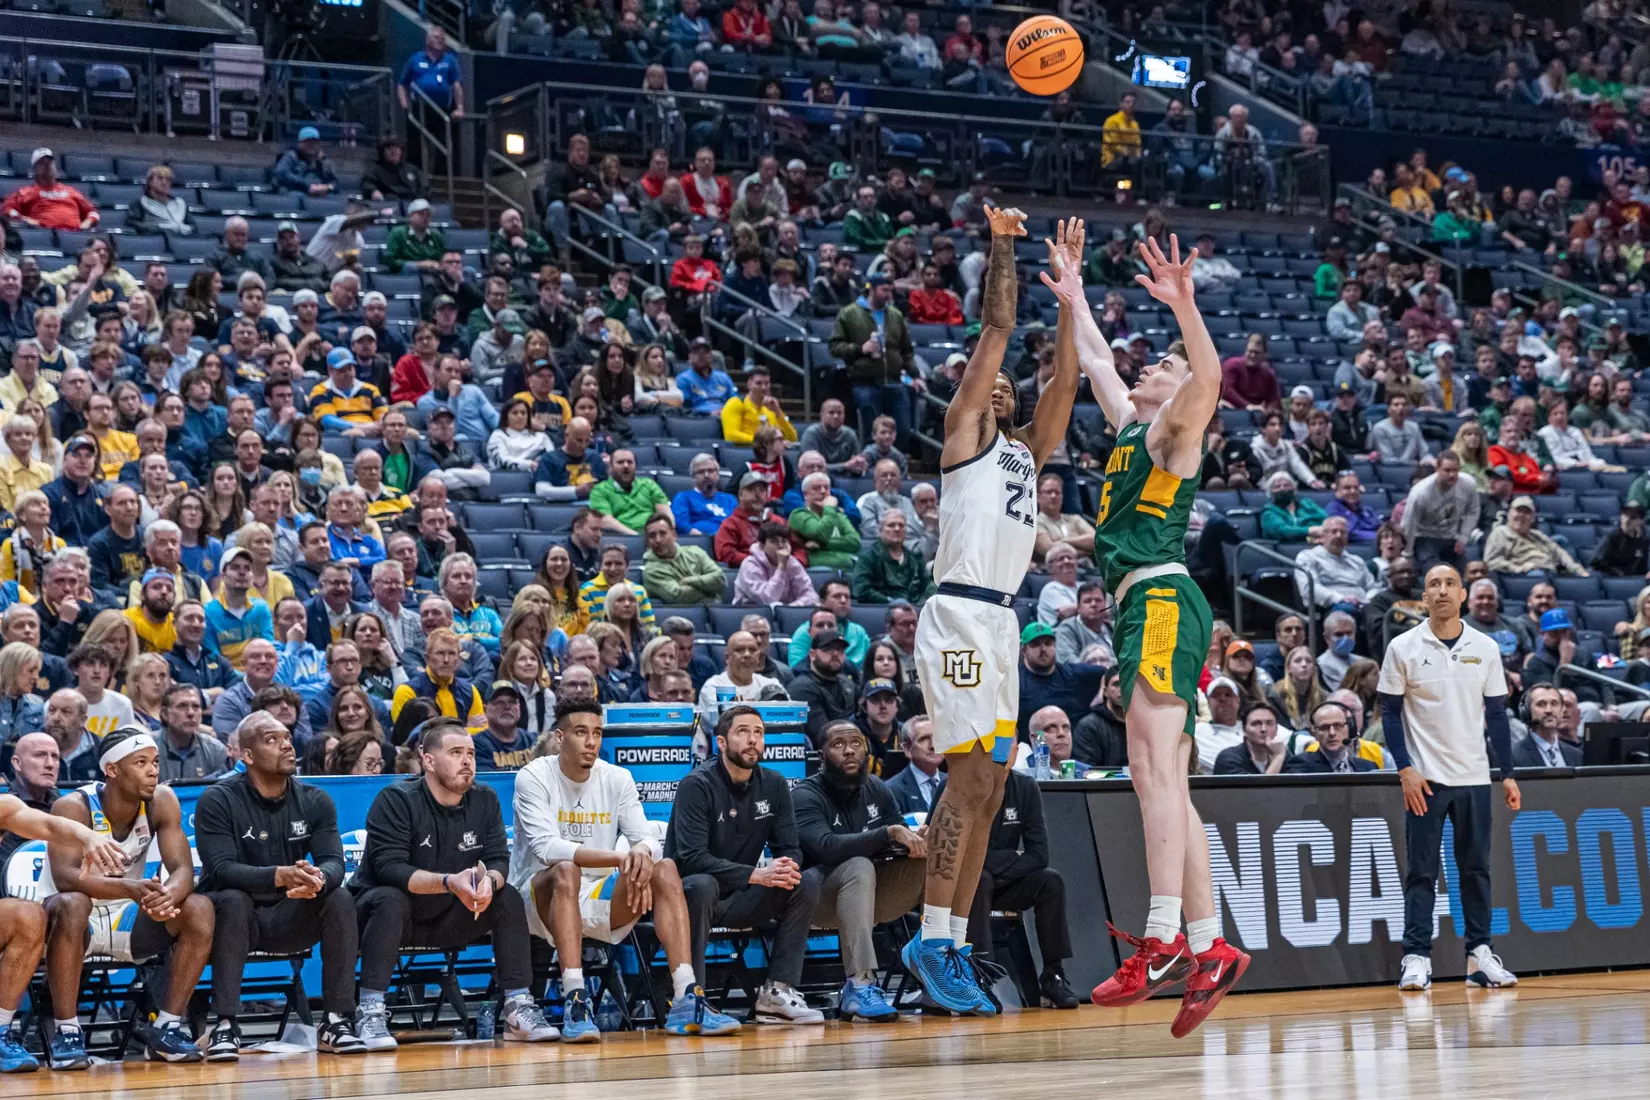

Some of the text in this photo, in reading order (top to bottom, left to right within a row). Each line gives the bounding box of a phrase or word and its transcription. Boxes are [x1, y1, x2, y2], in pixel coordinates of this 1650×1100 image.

[1016, 26, 1067, 51] Wilson
[802, 88, 850, 119] 14
[941, 649, 983, 689] MU
[617, 748, 690, 763] POWERADE
[763, 746, 805, 760] WERADE
[643, 782, 672, 791] MARCH
[1203, 807, 1650, 950] NCA.CO
